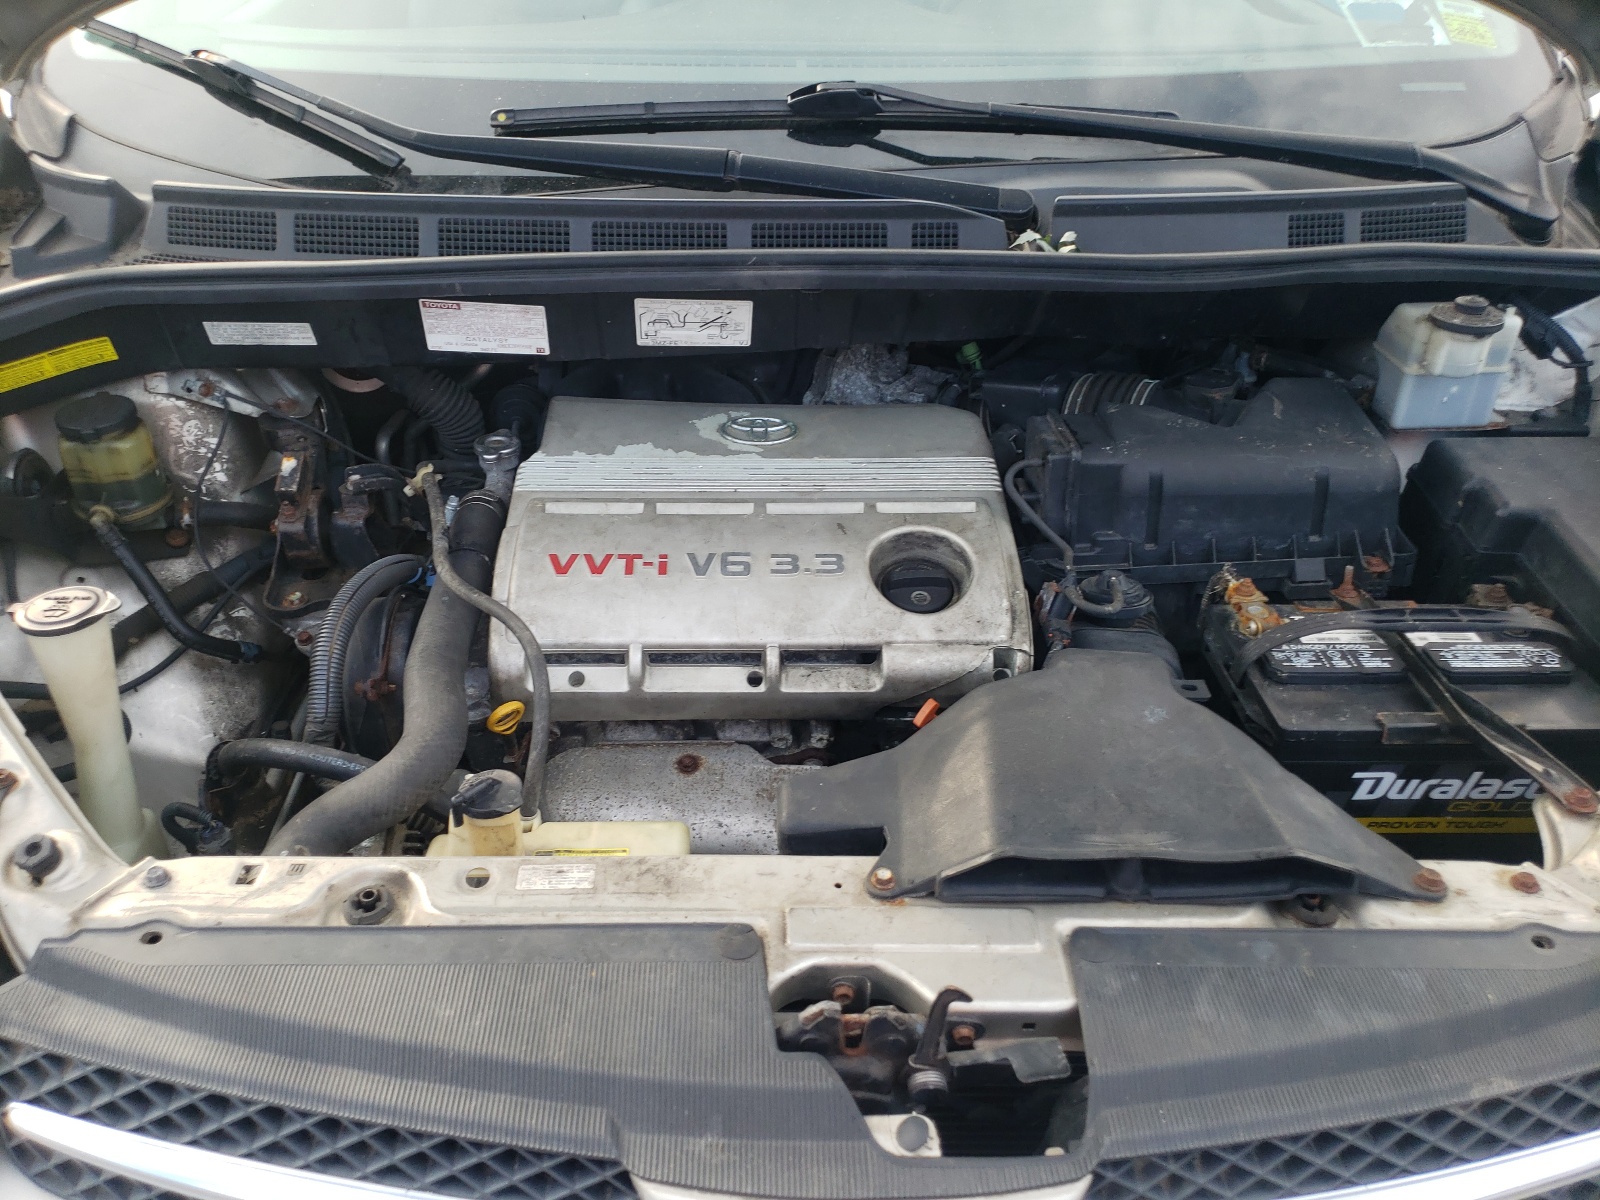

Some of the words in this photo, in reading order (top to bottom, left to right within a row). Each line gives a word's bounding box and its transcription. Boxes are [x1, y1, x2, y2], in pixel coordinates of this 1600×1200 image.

[548, 553, 669, 576] VVT-i
[687, 552, 751, 577] V6
[770, 552, 845, 577] 3.3
[1448, 801, 1532, 812] GOLD
[1366, 821, 1440, 829] PROVEN
[1446, 821, 1509, 829] TOUGH
